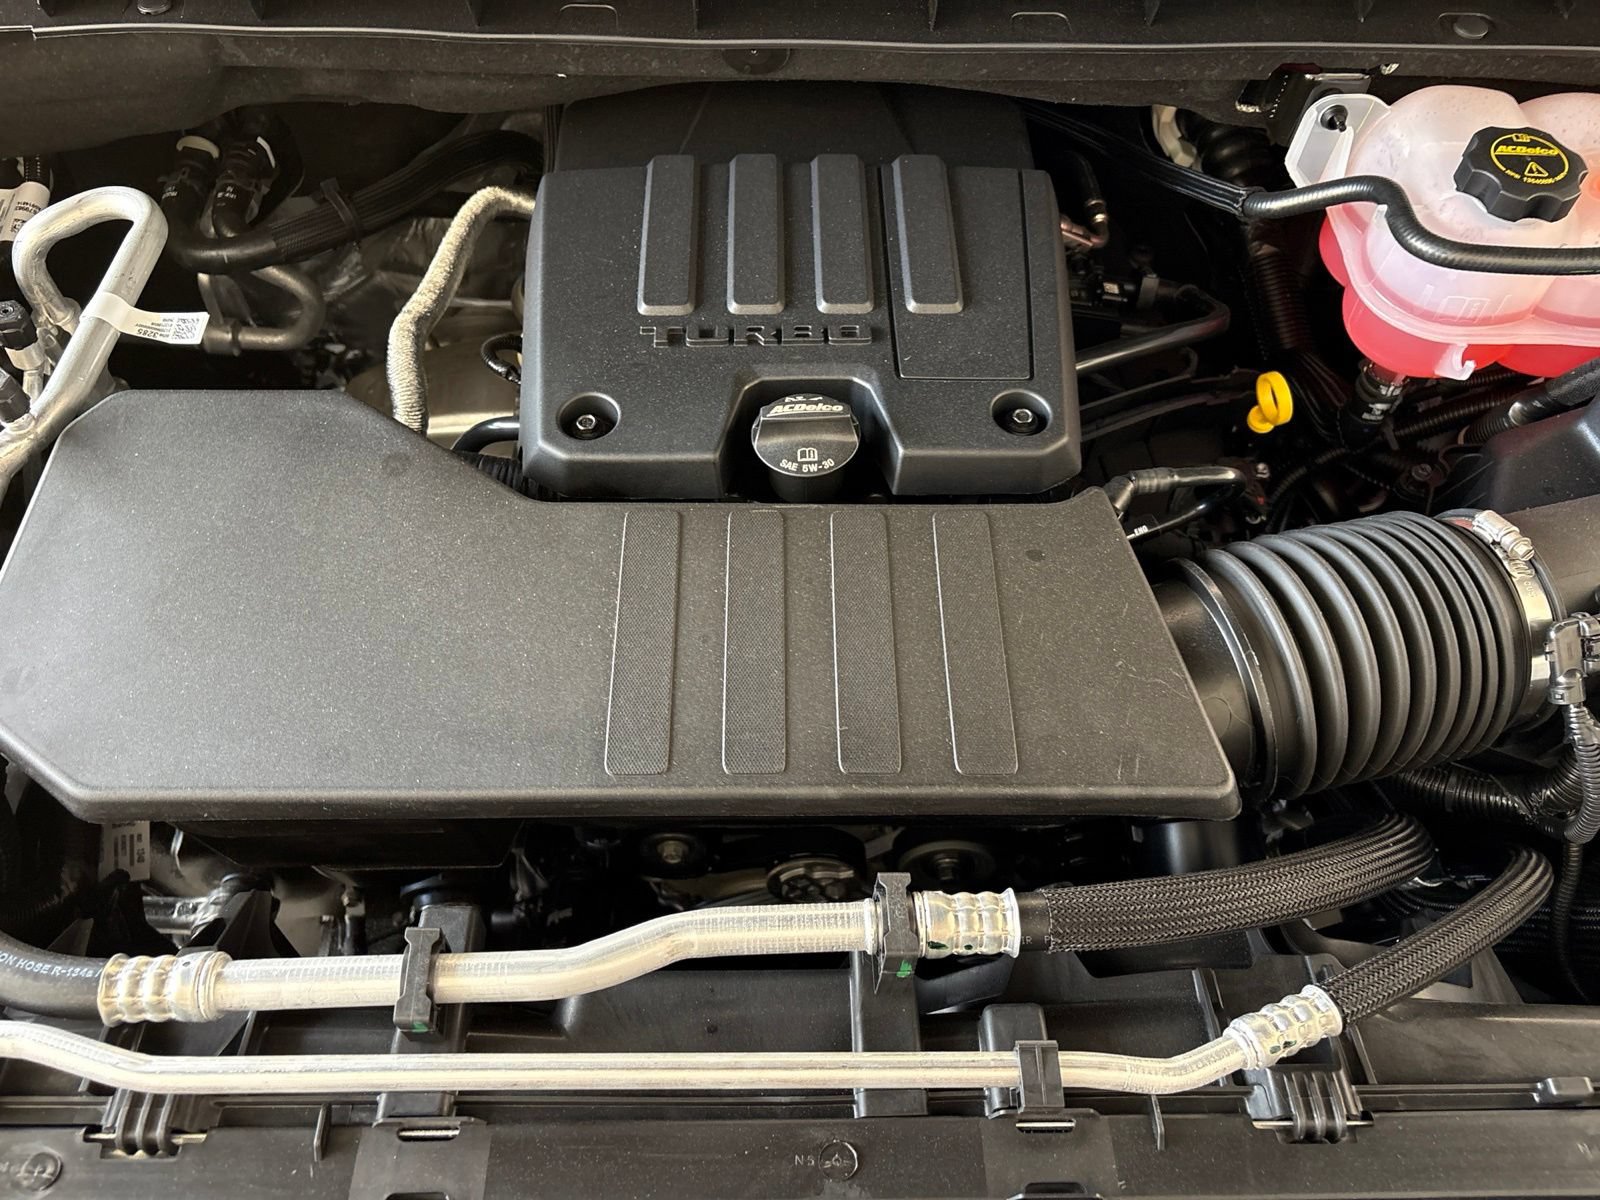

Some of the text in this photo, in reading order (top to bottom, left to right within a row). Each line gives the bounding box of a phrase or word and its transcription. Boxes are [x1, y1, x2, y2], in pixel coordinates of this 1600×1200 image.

[1494, 145, 1560, 156] ACDelco
[137, 328, 159, 338] 3285
[639, 325, 872, 348] TURBO
[767, 403, 844, 416] ACDelco
[779, 458, 835, 472] SAE 5W-30
[15, 958, 52, 975] HOSE
